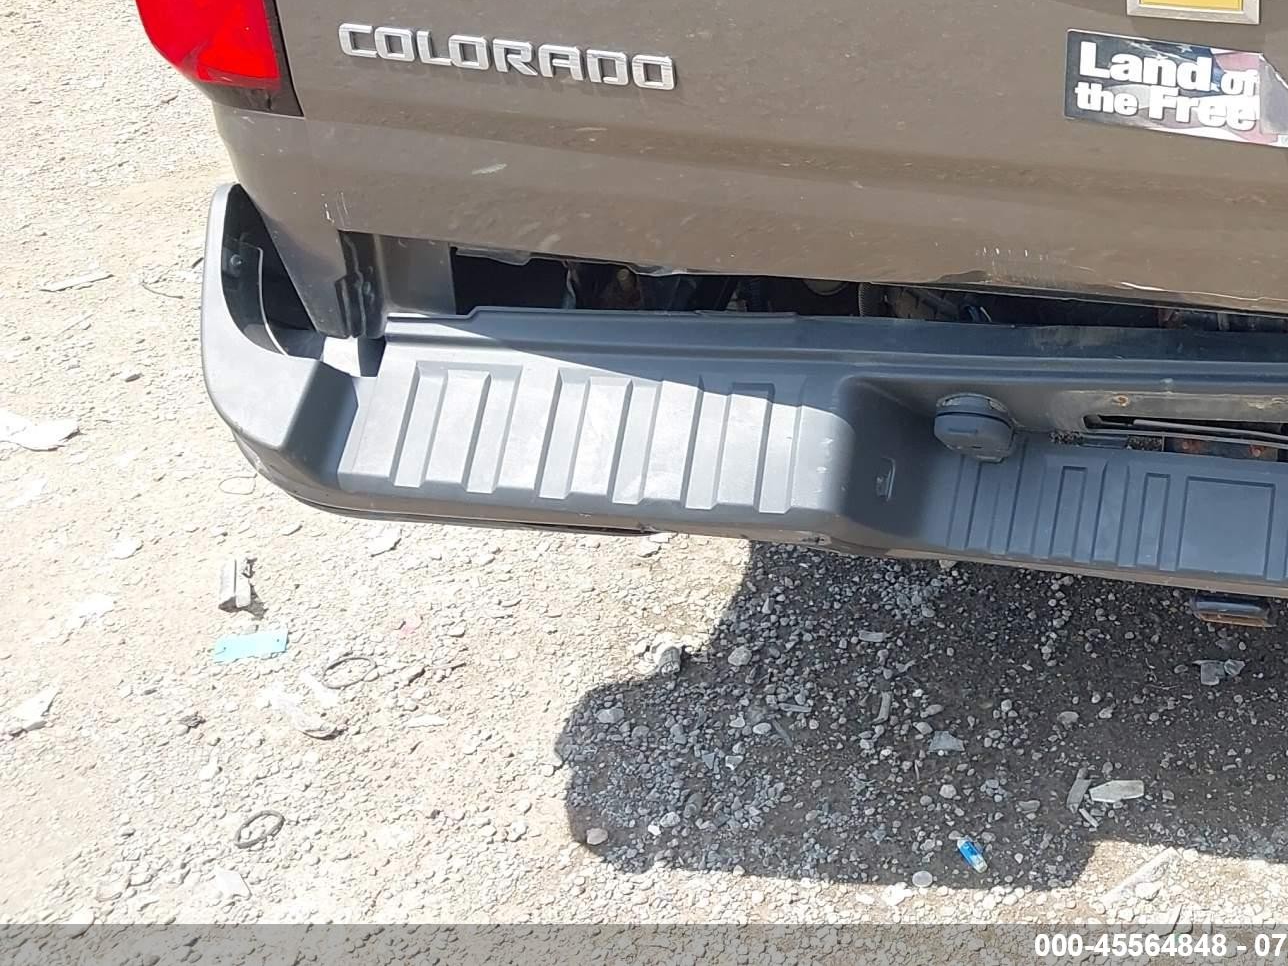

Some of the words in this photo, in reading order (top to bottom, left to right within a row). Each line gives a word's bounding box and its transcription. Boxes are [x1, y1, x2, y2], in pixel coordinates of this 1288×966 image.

[338, 22, 677, 92] COLORADO
[1079, 40, 1213, 93] Land
[1219, 67, 1261, 96] of
[1074, 81, 1139, 117] the
[1148, 84, 1261, 132] Free
